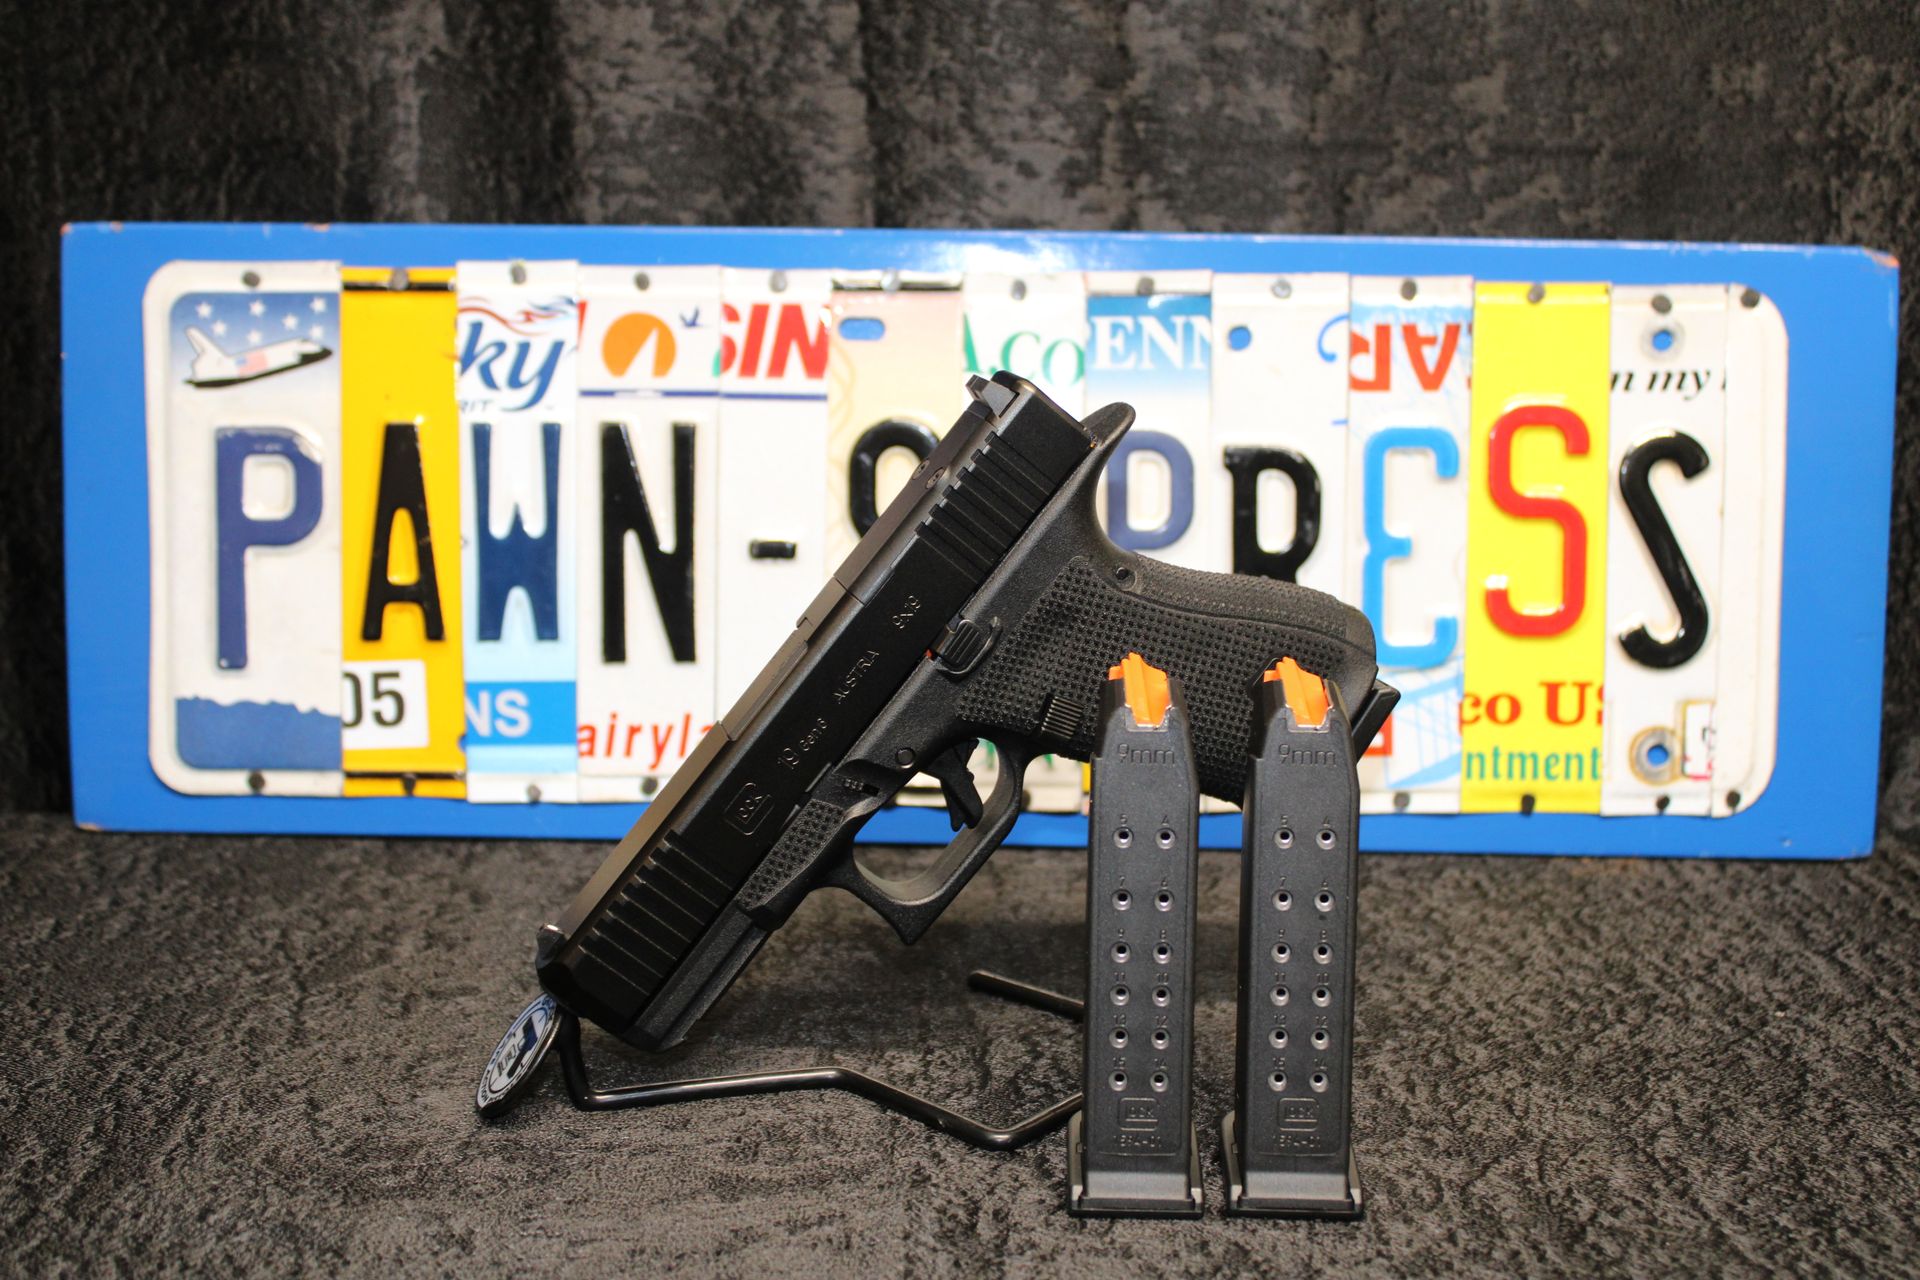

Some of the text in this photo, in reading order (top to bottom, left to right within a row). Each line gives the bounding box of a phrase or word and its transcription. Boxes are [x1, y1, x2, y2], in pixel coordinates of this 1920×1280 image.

[1647, 369, 1711, 402] my
[776, 746, 799, 770] 19
[832, 650, 880, 705] AUSTRIA
[578, 713, 714, 772] airyl
[1118, 743, 1176, 765] 9mm
[1278, 744, 1337, 767] 9mm
